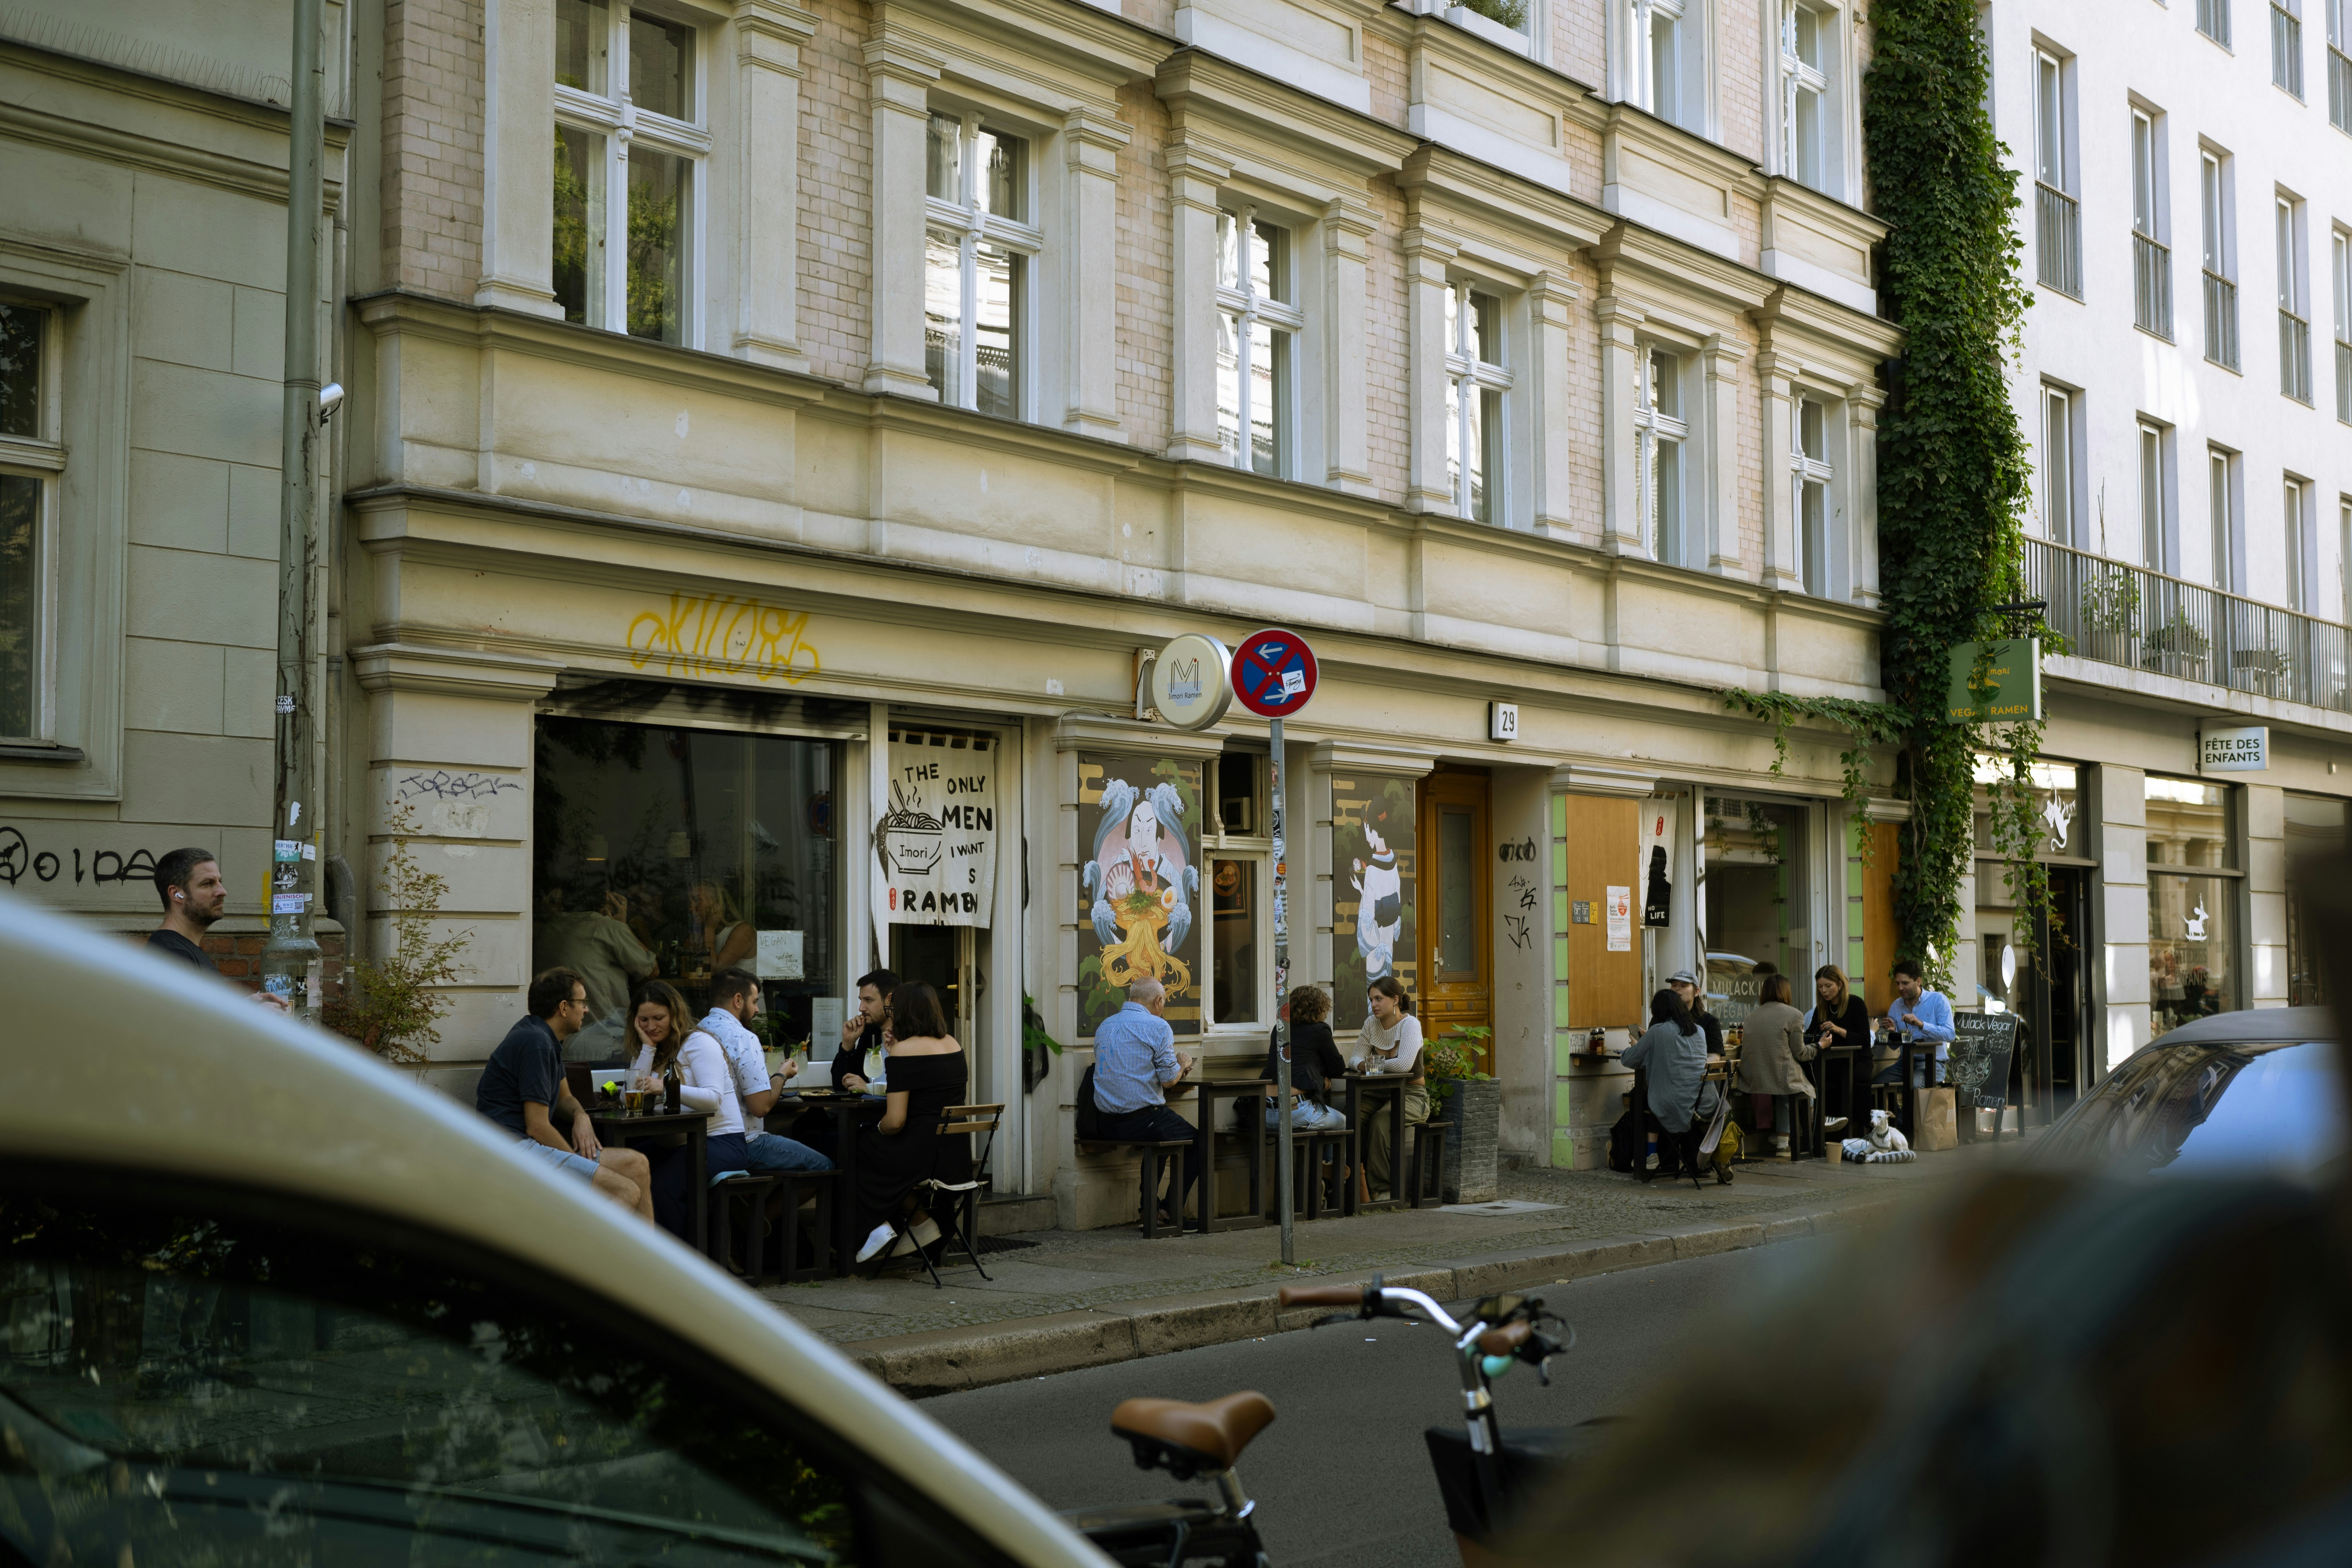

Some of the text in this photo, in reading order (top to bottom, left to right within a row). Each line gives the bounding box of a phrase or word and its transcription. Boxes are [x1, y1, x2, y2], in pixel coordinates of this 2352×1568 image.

[1991, 705, 2028, 715] RAMEN
[1502, 711, 1514, 732] 29
[2205, 737, 2259, 750] FÊTE DES
[2205, 751, 2260, 763] ENFANTS
[905, 763, 939, 783] THE
[947, 775, 986, 795] ONLY
[942, 804, 993, 831] MEN
[951, 842, 985, 858] I WANT
[903, 889, 978, 914] RAMEN
[1650, 911, 1665, 920] LIFE
[760, 935, 786, 946] VEGAN
[1713, 981, 1755, 996] MULACK
[1715, 1003, 1751, 1019] VEGAN
[1956, 1013, 1986, 1030] Mulack
[1973, 1088, 2005, 1107] Ramen
